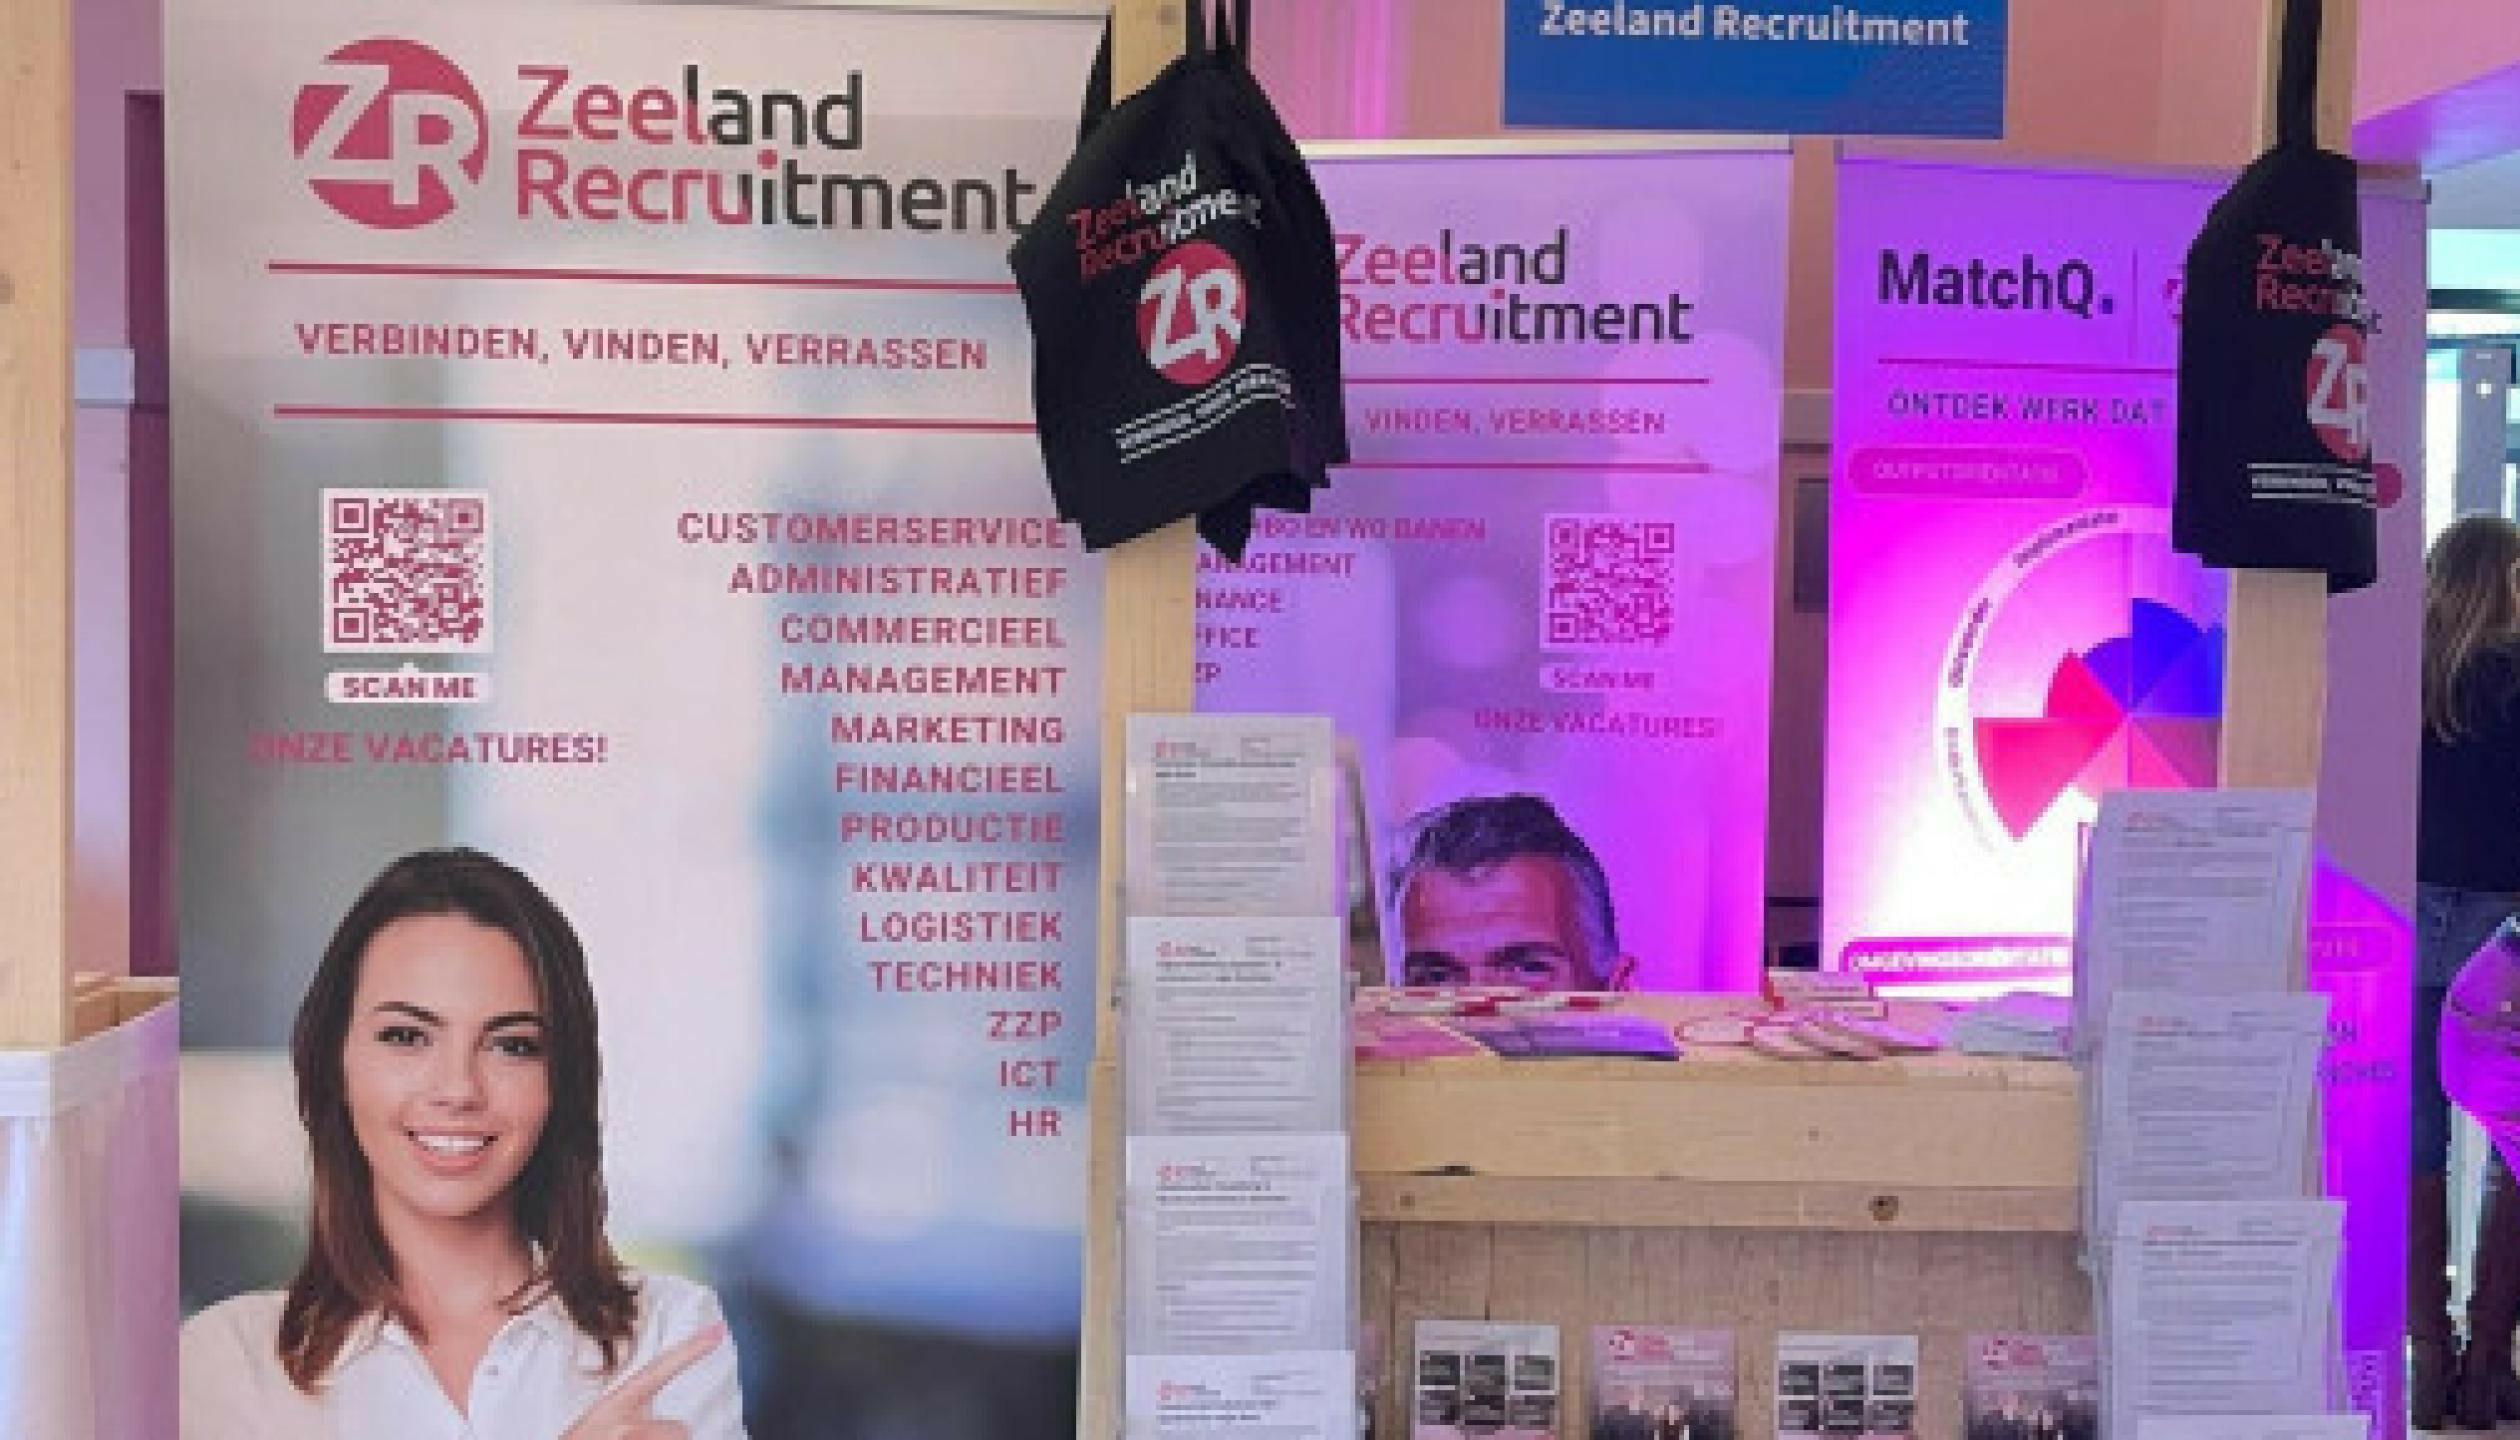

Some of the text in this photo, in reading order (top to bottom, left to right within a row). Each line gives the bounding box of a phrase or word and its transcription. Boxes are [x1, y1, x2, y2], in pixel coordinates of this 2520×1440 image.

[1539, 1, 1970, 47] Zeeland Recruitment
[516, 64, 863, 151] Zeeland
[294, 44, 485, 222] ZR
[516, 149, 1040, 235] Recruitment
[1336, 226, 1568, 286] Zeeland
[1877, 248, 2115, 321] MatchQ.
[1137, 255, 1246, 378] ZR
[1339, 288, 1696, 345] Recruitment
[296, 322, 988, 372] VERBINDEN, VINDEN, VERRASSEN
[1365, 407, 1667, 436] VINDEN, VERRASSEN
[1887, 391, 2166, 426] ONTDEK WERK DAT
[676, 512, 1068, 550] CUSTOMERSERVICE
[729, 563, 1068, 598] ADMINISTRATIEF
[780, 613, 1065, 649] COMMERCIEEL
[342, 675, 477, 701] SCAN ME
[780, 664, 1066, 697] MANAGEMENT
[831, 713, 1065, 746] MARKETING
[248, 733, 608, 766] ONZE VACATURES!
[836, 763, 1064, 795] FINANCIEEL
[841, 813, 1064, 845] PRODUCTIE
[852, 863, 1062, 894] KWALITEIT
[860, 912, 1063, 944] LOGISTIEK
[868, 961, 1063, 992] TECHNIEK
[985, 1011, 1063, 1041] ZZP
[999, 1060, 1061, 1089] ICT
[1009, 1110, 1062, 1139] HR
